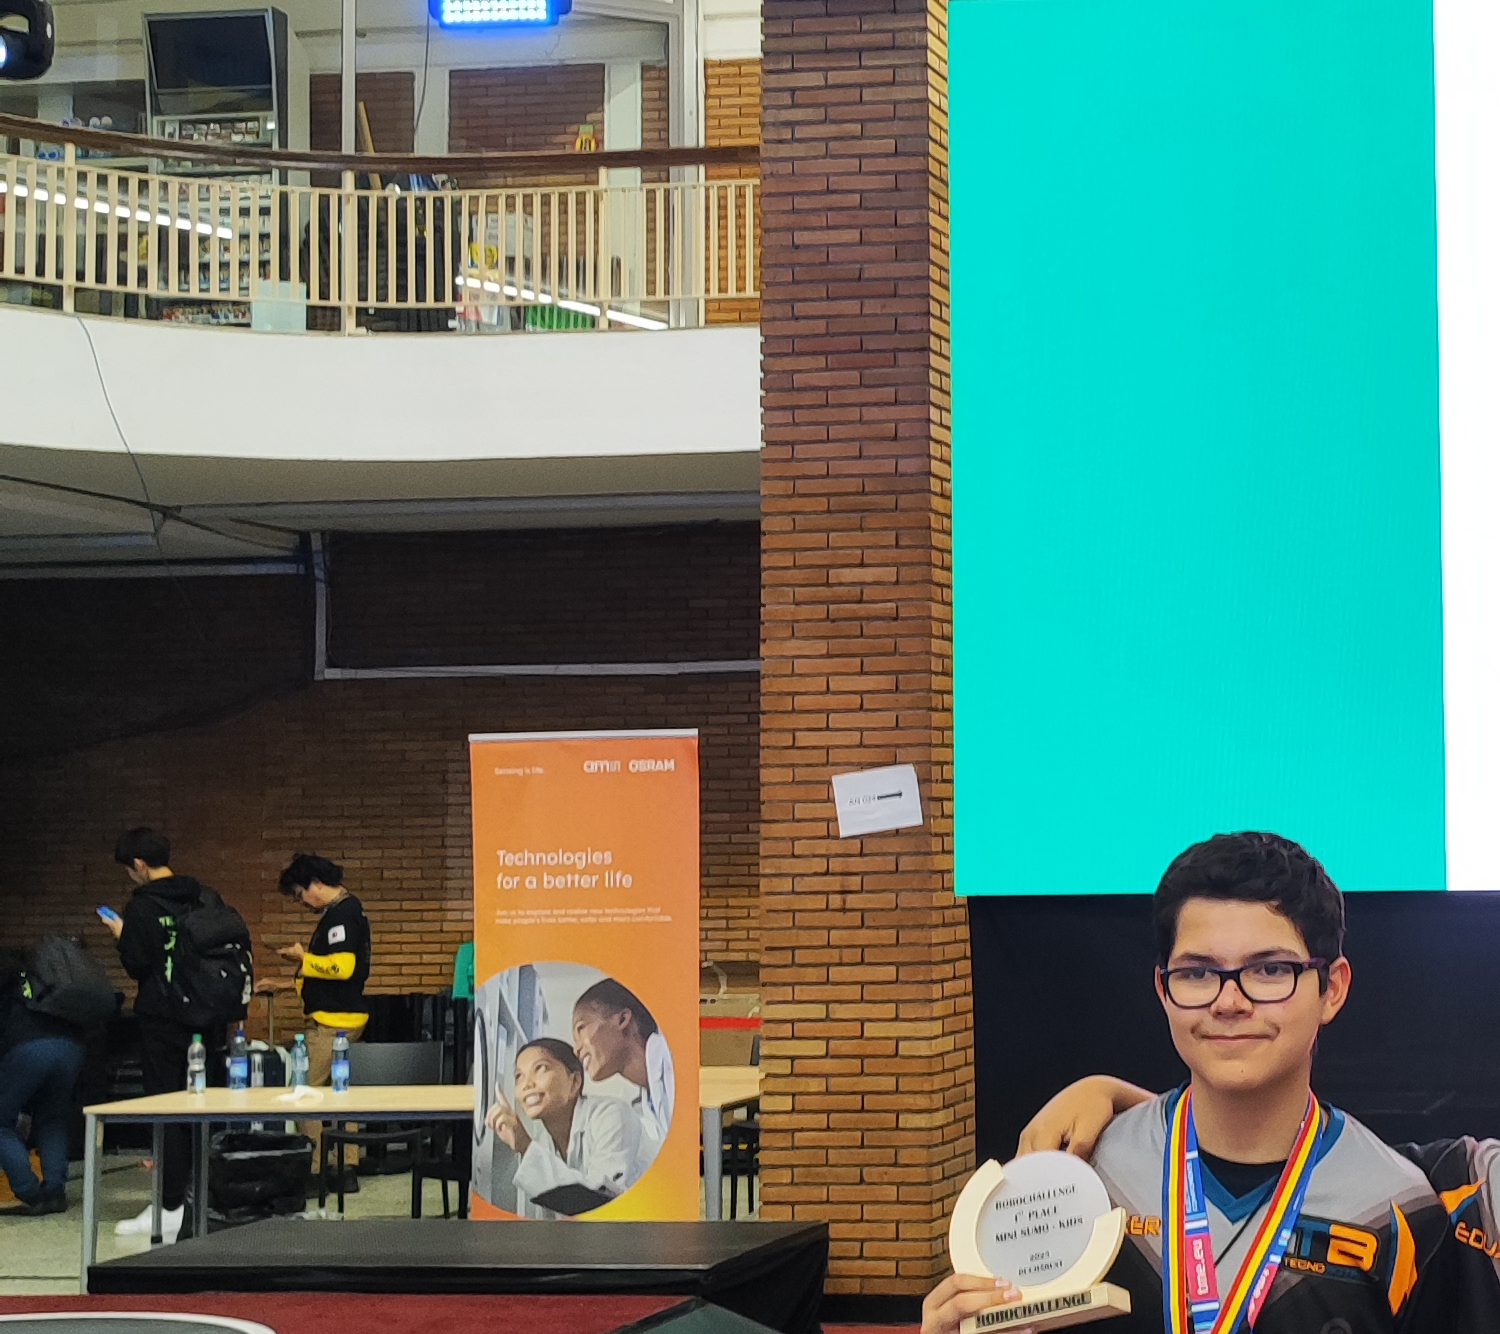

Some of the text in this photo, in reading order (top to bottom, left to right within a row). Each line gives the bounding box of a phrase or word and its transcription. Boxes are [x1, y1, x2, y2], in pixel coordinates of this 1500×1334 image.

[496, 847, 613, 870] Technologies
[496, 869, 633, 890] for a better life
